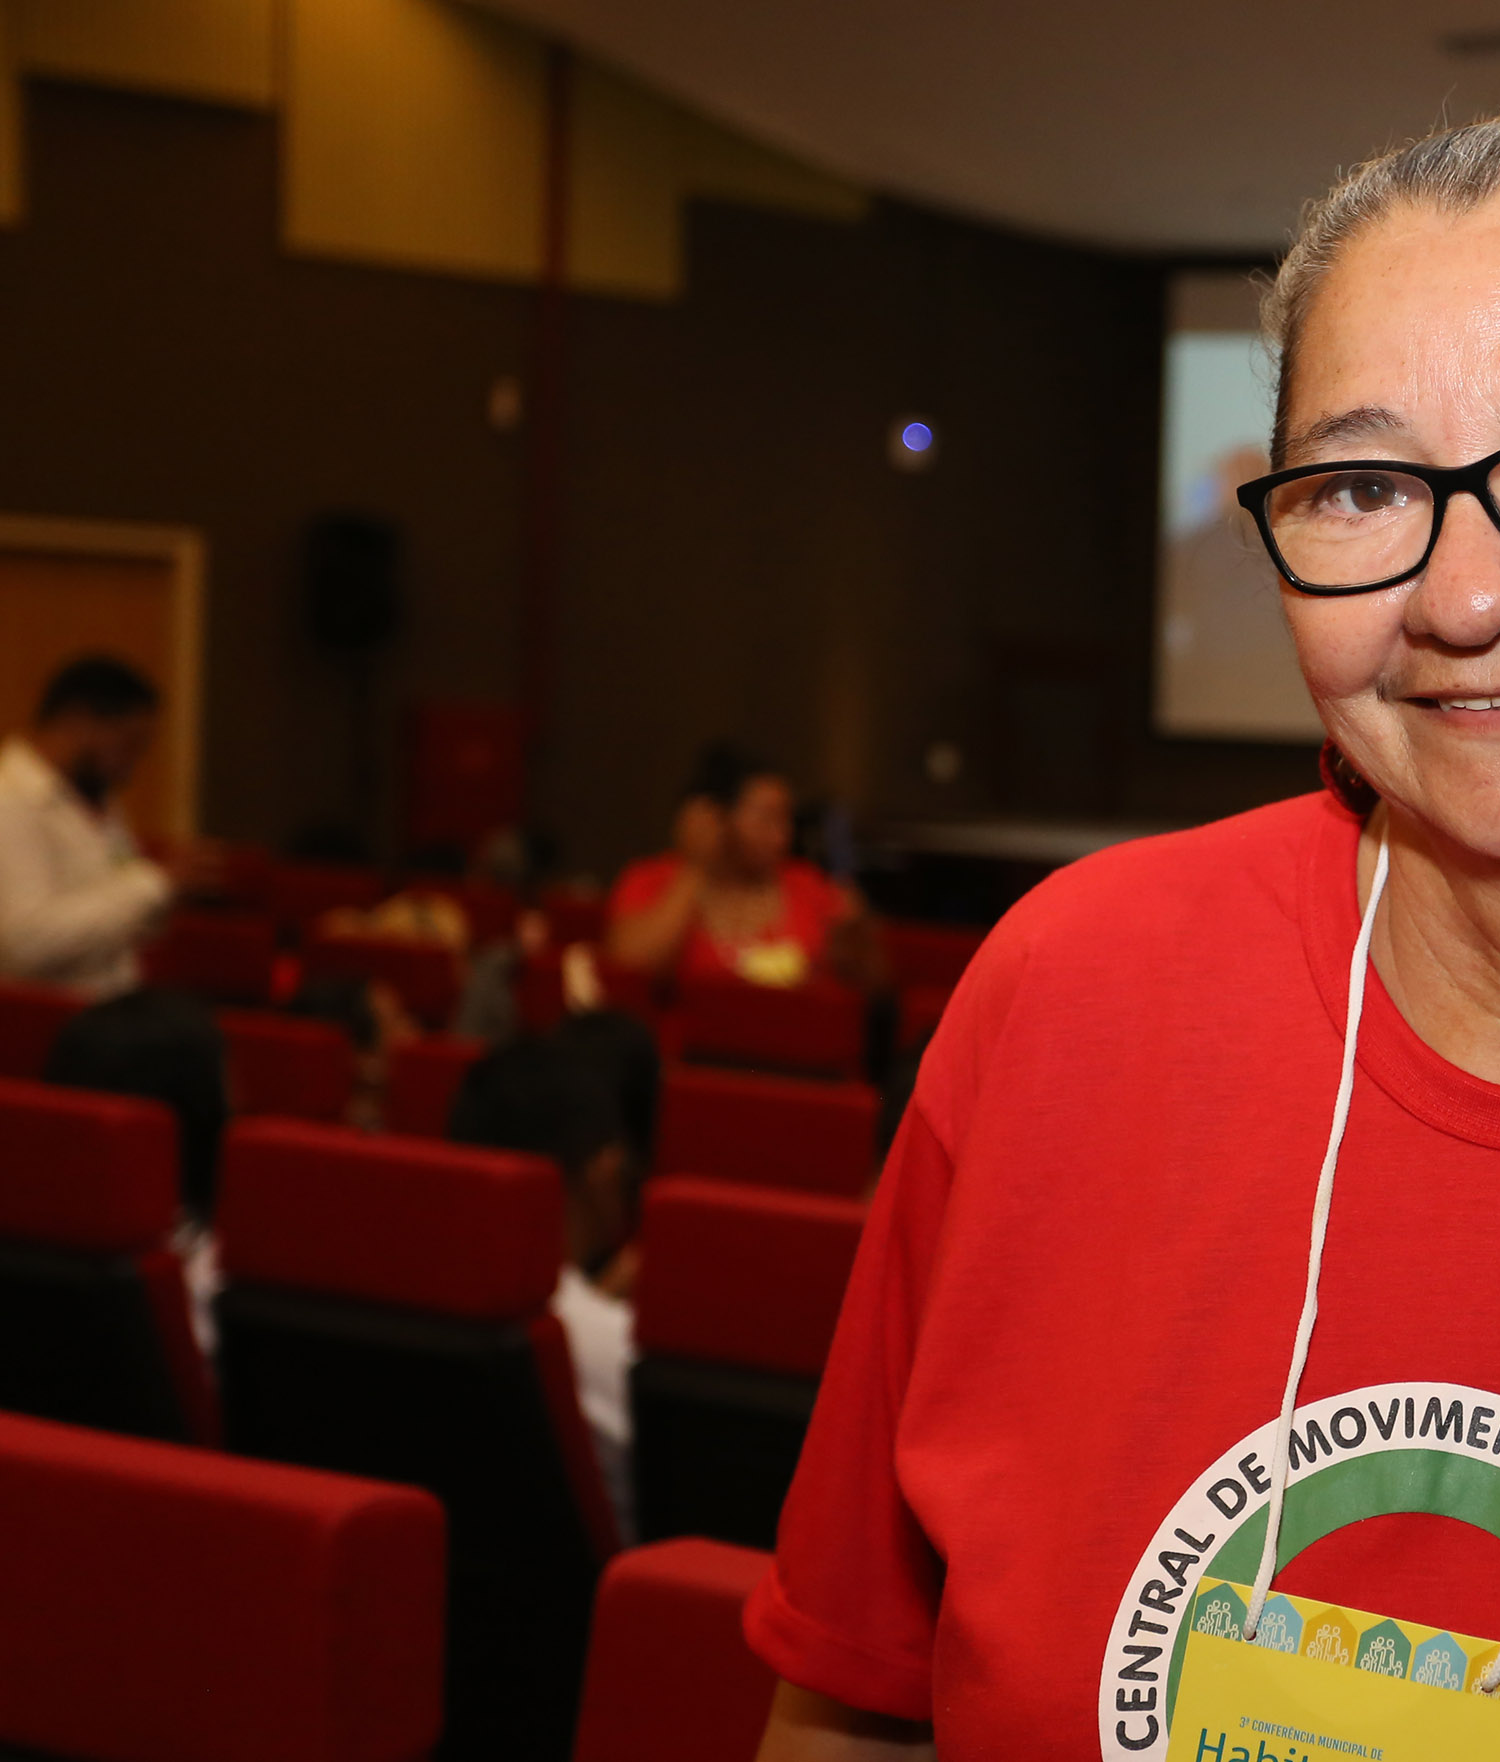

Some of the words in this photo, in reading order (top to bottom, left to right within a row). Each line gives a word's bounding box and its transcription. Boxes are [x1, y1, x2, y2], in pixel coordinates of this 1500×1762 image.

[1115, 1527, 1216, 1751] CENTRAL
[1206, 1452, 1272, 1520] DE
[1251, 1719, 1315, 1745] CONFERÊNCIA
[1317, 1735, 1368, 1758] MUNICIPAL
[1370, 1748, 1384, 1761] DE
